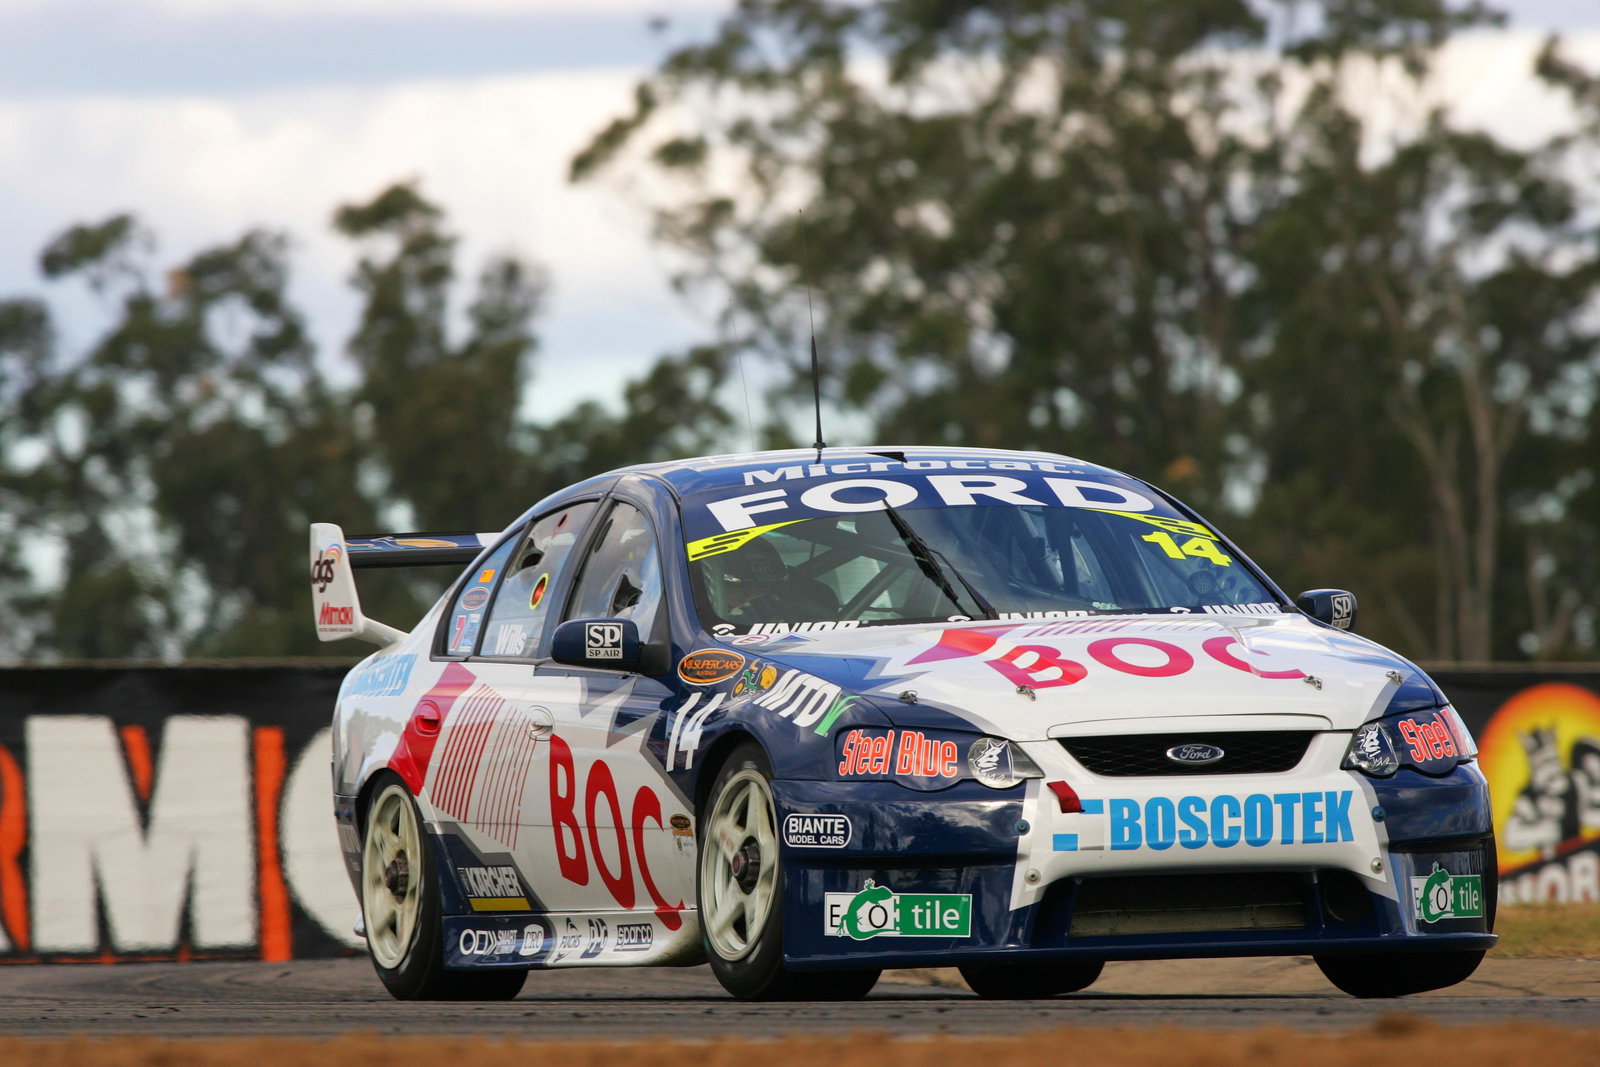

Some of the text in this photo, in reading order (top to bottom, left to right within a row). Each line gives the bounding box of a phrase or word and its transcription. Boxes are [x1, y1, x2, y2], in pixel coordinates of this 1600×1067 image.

[743, 459, 1071, 486] Microcat
[706, 475, 1156, 533] FORD
[1142, 530, 1231, 568] 14
[1333, 596, 1352, 619] SP
[588, 625, 622, 649] SP
[588, 649, 621, 657] SP AIR
[984, 636, 1307, 690] BOC
[666, 692, 727, 772] 14
[1398, 713, 1459, 763] Steel
[839, 730, 958, 778] Steel Blue
[1180, 745, 1212, 759] Ford
[549, 734, 686, 931] BOC
[788, 817, 845, 835] BIANTE
[1109, 790, 1355, 851] BOSCOTEK
[788, 834, 845, 845] MODEL CARS
[1459, 881, 1479, 911] tile
[911, 900, 961, 930] tile
[617, 925, 652, 949] sparco
